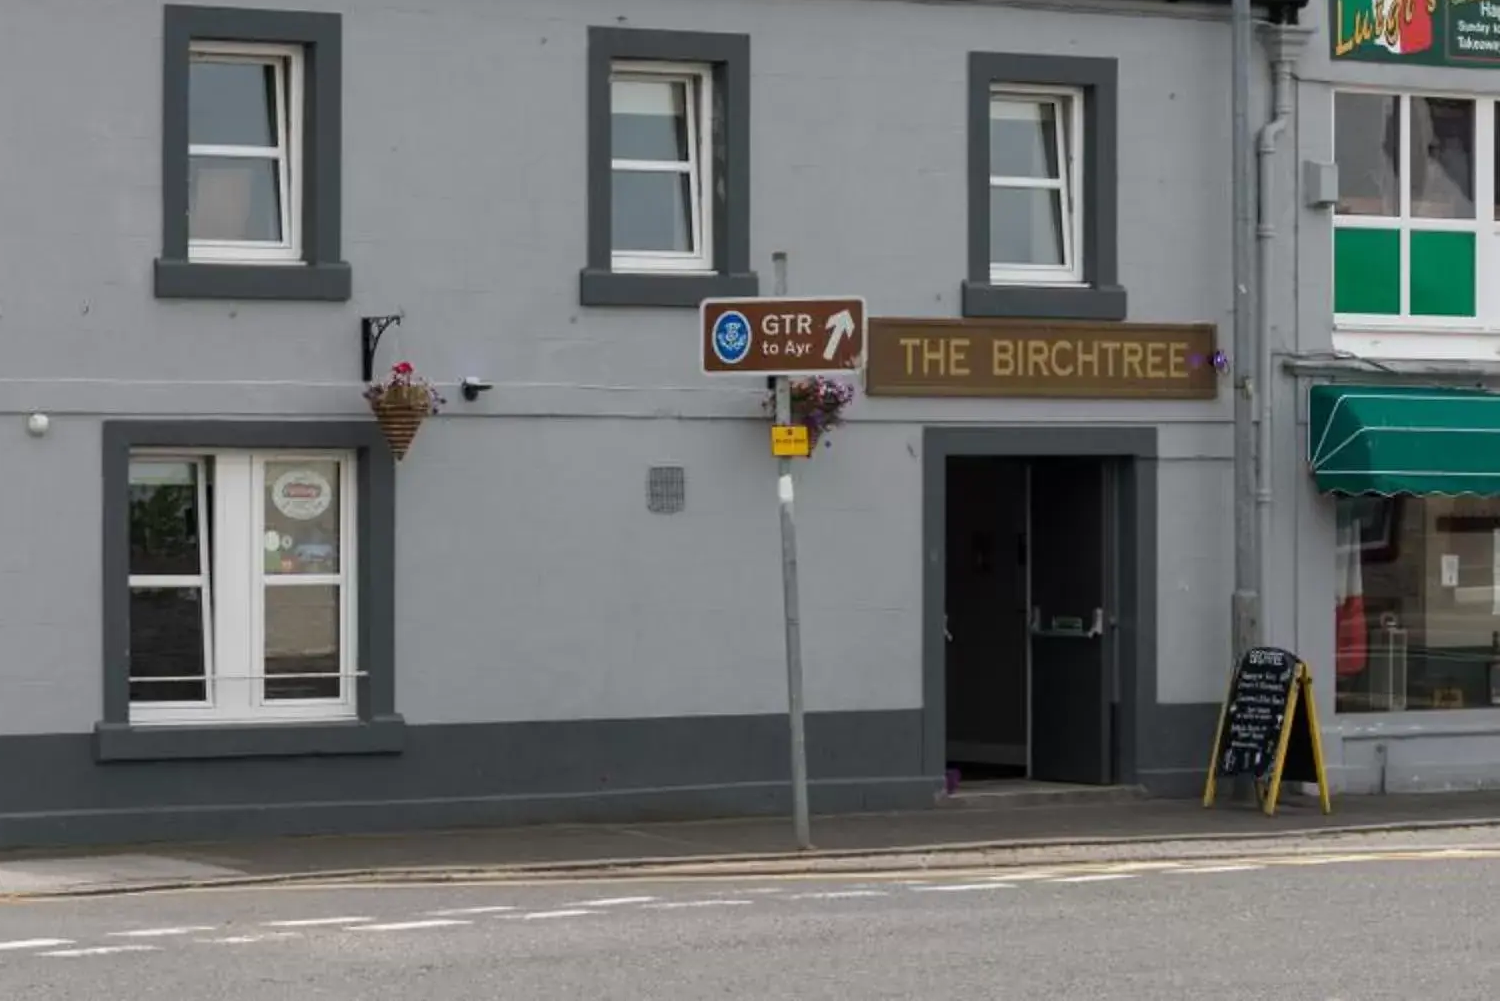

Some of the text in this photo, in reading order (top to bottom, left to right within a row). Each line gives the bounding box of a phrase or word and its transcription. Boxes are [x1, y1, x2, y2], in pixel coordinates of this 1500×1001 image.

[761, 313, 812, 336] GTR
[762, 340, 812, 357] to Ayr
[900, 338, 1189, 378] THE BIRCHTREE
